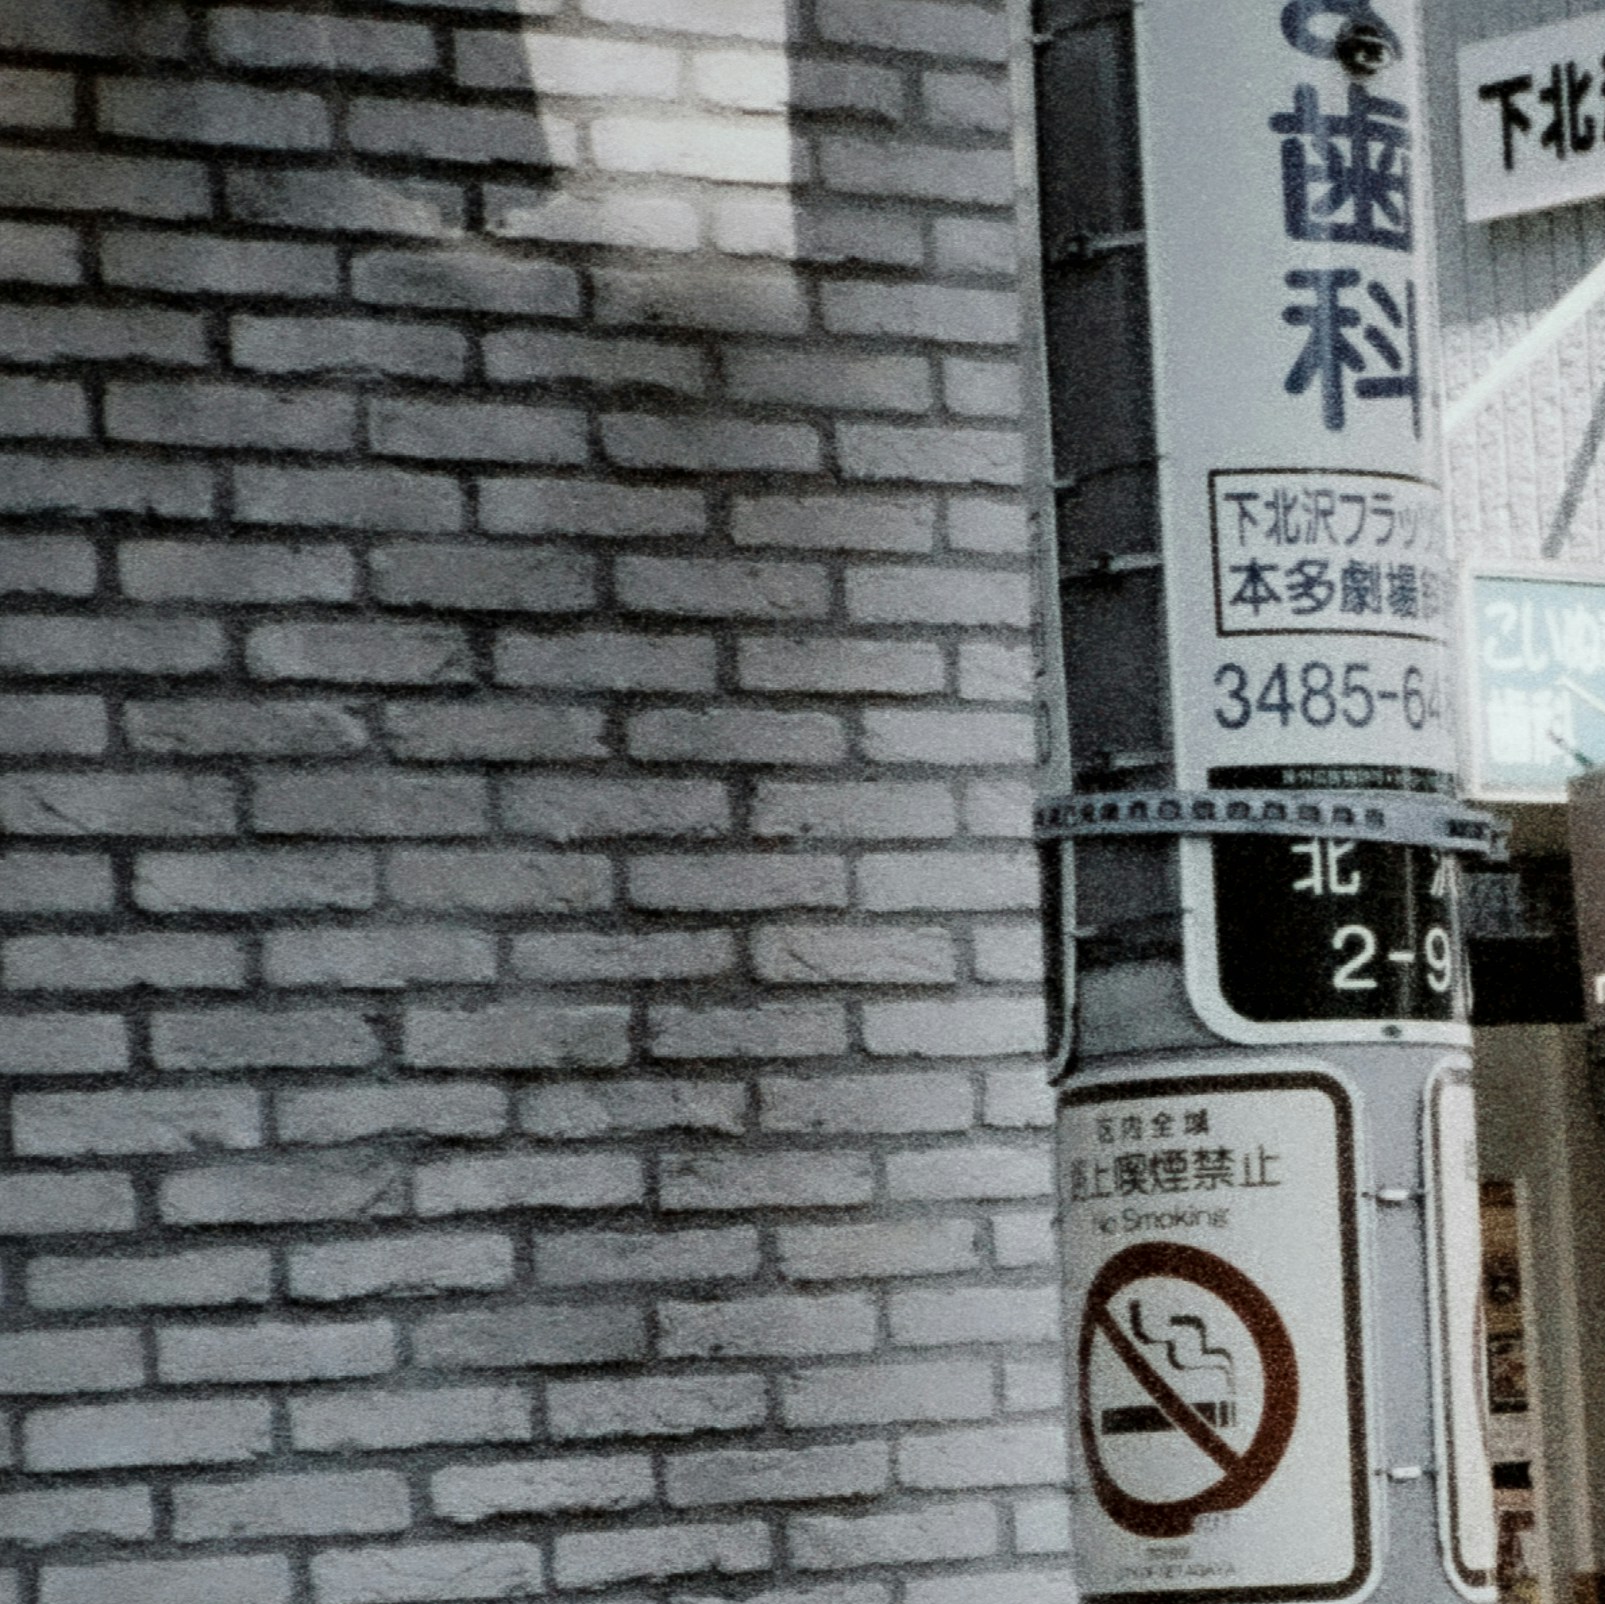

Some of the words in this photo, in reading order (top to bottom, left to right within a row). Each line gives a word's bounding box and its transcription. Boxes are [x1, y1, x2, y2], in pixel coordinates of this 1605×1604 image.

[1268, 0, 1422, 441] 歯科
[1332, 923, 1450, 993] 2-9
[1121, 1203, 1230, 1234] Smoking
